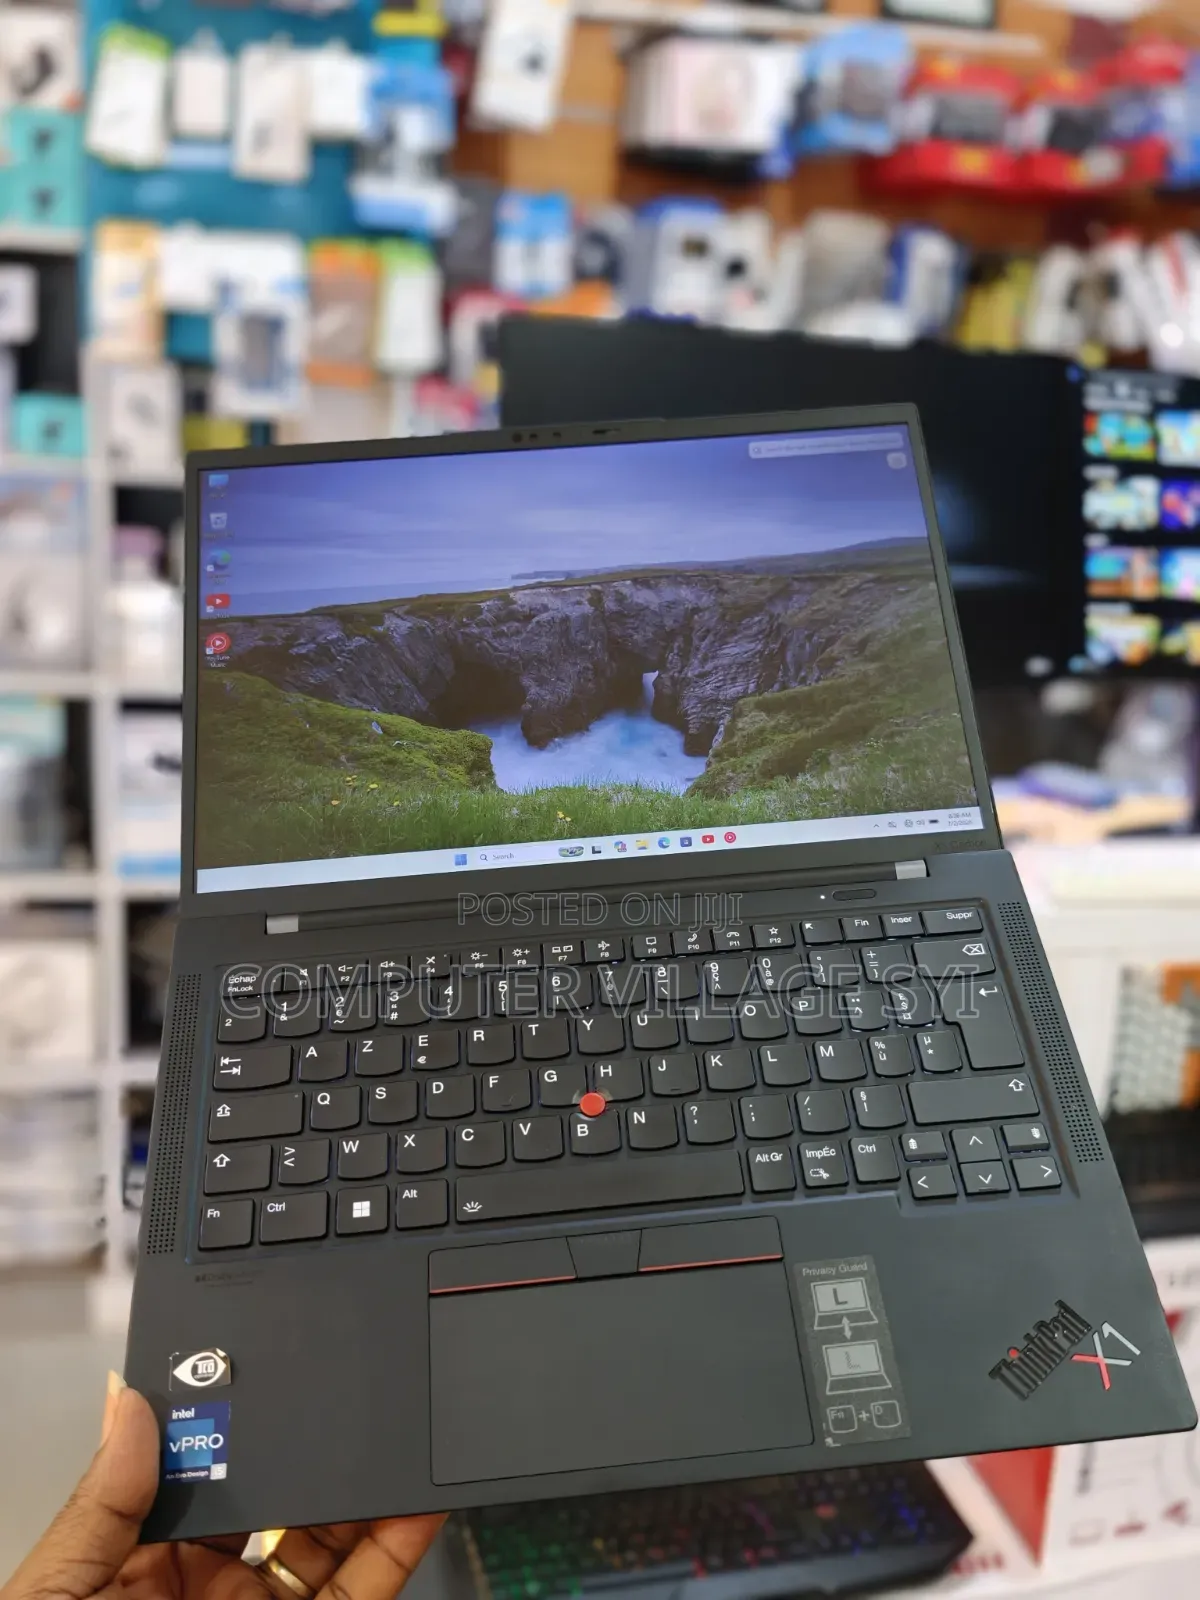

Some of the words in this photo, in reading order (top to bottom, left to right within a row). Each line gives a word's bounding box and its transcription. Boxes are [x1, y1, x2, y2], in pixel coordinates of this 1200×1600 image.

[492, 852, 515, 860] Search
[890, 916, 912, 925] Inser
[946, 911, 973, 922] Suppr
[854, 919, 870, 928] Fin
[729, 940, 741, 948] F11
[769, 937, 782, 945] F12
[687, 943, 700, 952] F10
[558, 955, 568, 963] F7
[657, 966, 667, 977] 8
[710, 962, 719, 973] 9
[340, 975, 351, 983] F2
[551, 975, 561, 987] 6
[605, 970, 613, 982] 7
[443, 985, 454, 996] 4
[498, 980, 508, 992] 5
[335, 996, 345, 1008] 2
[389, 991, 400, 1002] 3
[281, 1001, 288, 1012] 1
[744, 1004, 757, 1017] O
[798, 1000, 809, 1012] P
[582, 1018, 594, 1031] Y
[636, 1014, 648, 1026] U
[473, 1029, 485, 1042] R
[528, 1023, 539, 1036] T
[362, 1040, 374, 1053] Z
[418, 1034, 429, 1047] E
[874, 1041, 886, 1049] %
[305, 1046, 318, 1059] A
[766, 1050, 778, 1062] L
[819, 1045, 834, 1058] M
[657, 1059, 667, 1072] J
[710, 1054, 723, 1067] K
[544, 1070, 558, 1083] G
[600, 1065, 613, 1077] H
[432, 1081, 444, 1094] D
[489, 1075, 499, 1088] F
[317, 1092, 330, 1105] Q
[375, 1087, 387, 1099] S
[690, 1106, 698, 1116] ?
[632, 1111, 646, 1124] N
[461, 1128, 474, 1141] C
[519, 1122, 531, 1136] V
[577, 1123, 589, 1137] B
[342, 1140, 360, 1153] W
[403, 1134, 416, 1147] X
[806, 1147, 836, 1159] ImpÉc
[858, 1144, 876, 1154] Ctrl
[402, 1189, 418, 1198] Alt
[207, 1208, 220, 1218] Fn
[267, 1202, 286, 1212] Ctrl
[802, 1267, 837, 1277] Privacy
[838, 1261, 868, 1273] Guard
[988, 1299, 1093, 1401] ThinkPad
[1071, 1321, 1141, 1391] X1
[172, 1408, 195, 1419] intel
[830, 1409, 845, 1420] Fn
[874, 1405, 884, 1416] D
[169, 1433, 224, 1453] vPRO
